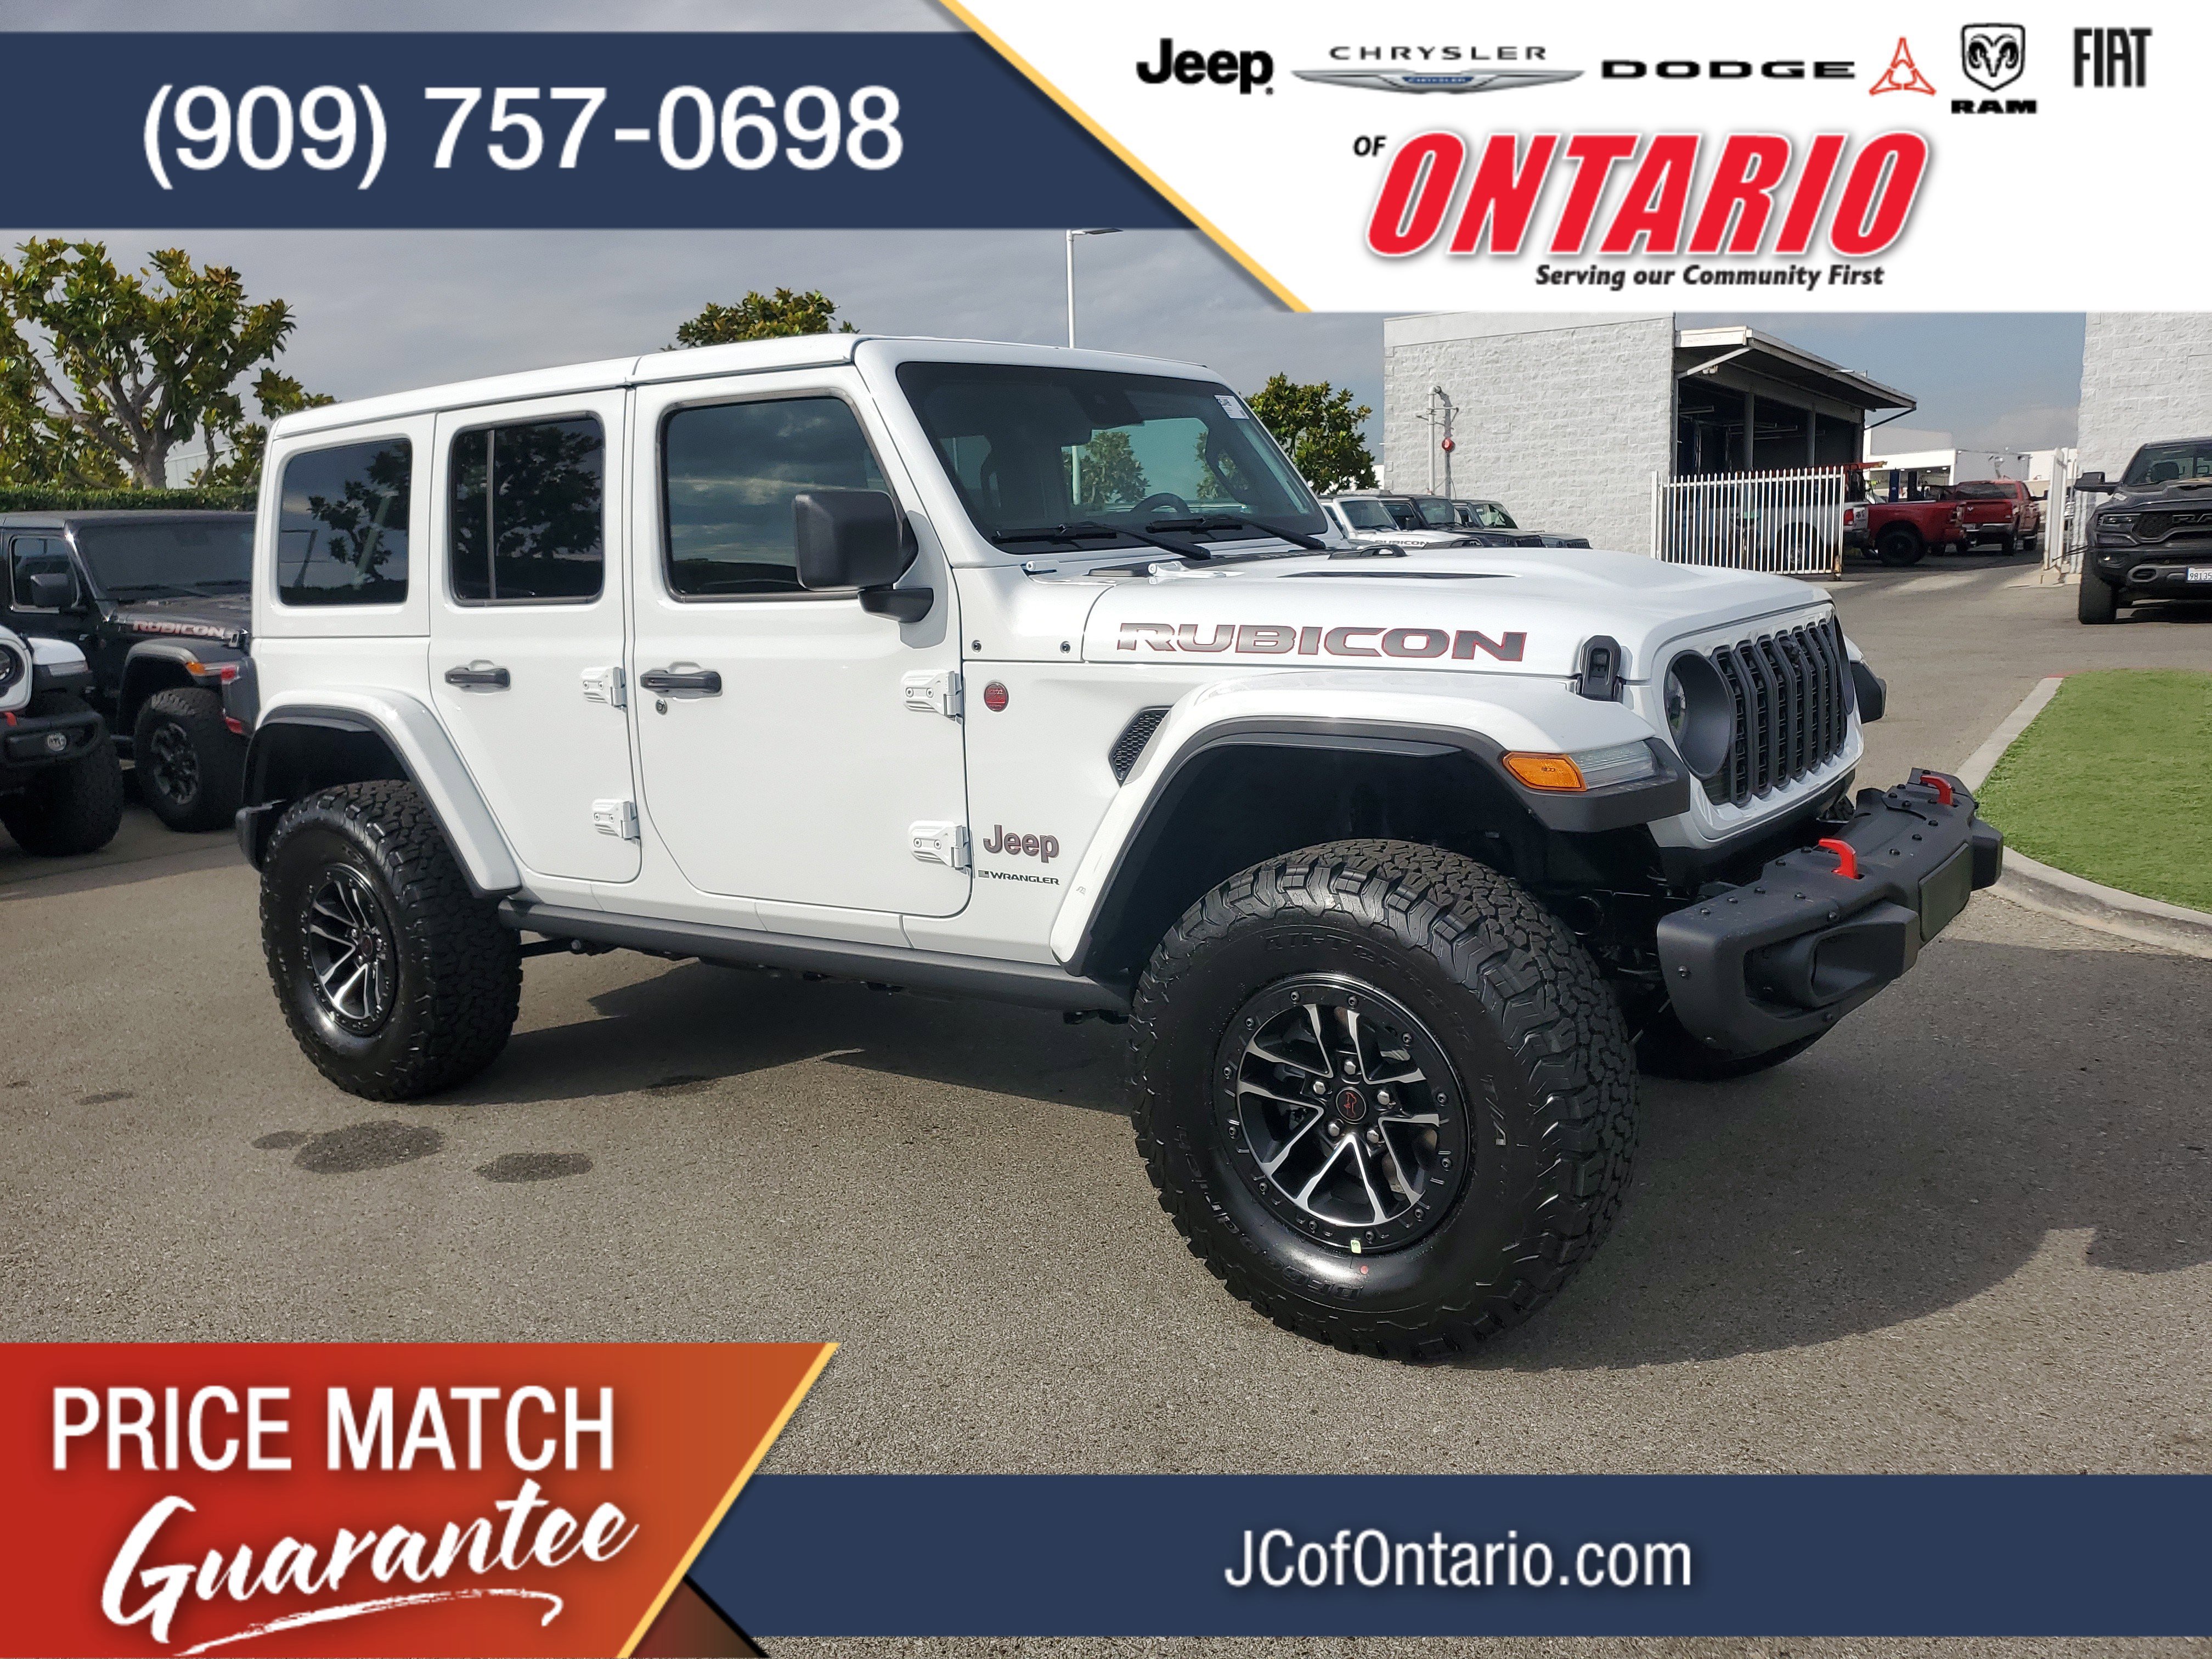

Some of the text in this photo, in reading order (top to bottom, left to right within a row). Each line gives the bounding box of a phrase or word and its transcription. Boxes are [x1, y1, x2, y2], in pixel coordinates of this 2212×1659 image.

[133, 620, 226, 640] RUBICON
[1116, 623, 1527, 662] RUBICON
[983, 824, 1060, 863] Jeep
[990, 871, 1059, 885] WRANGLER
